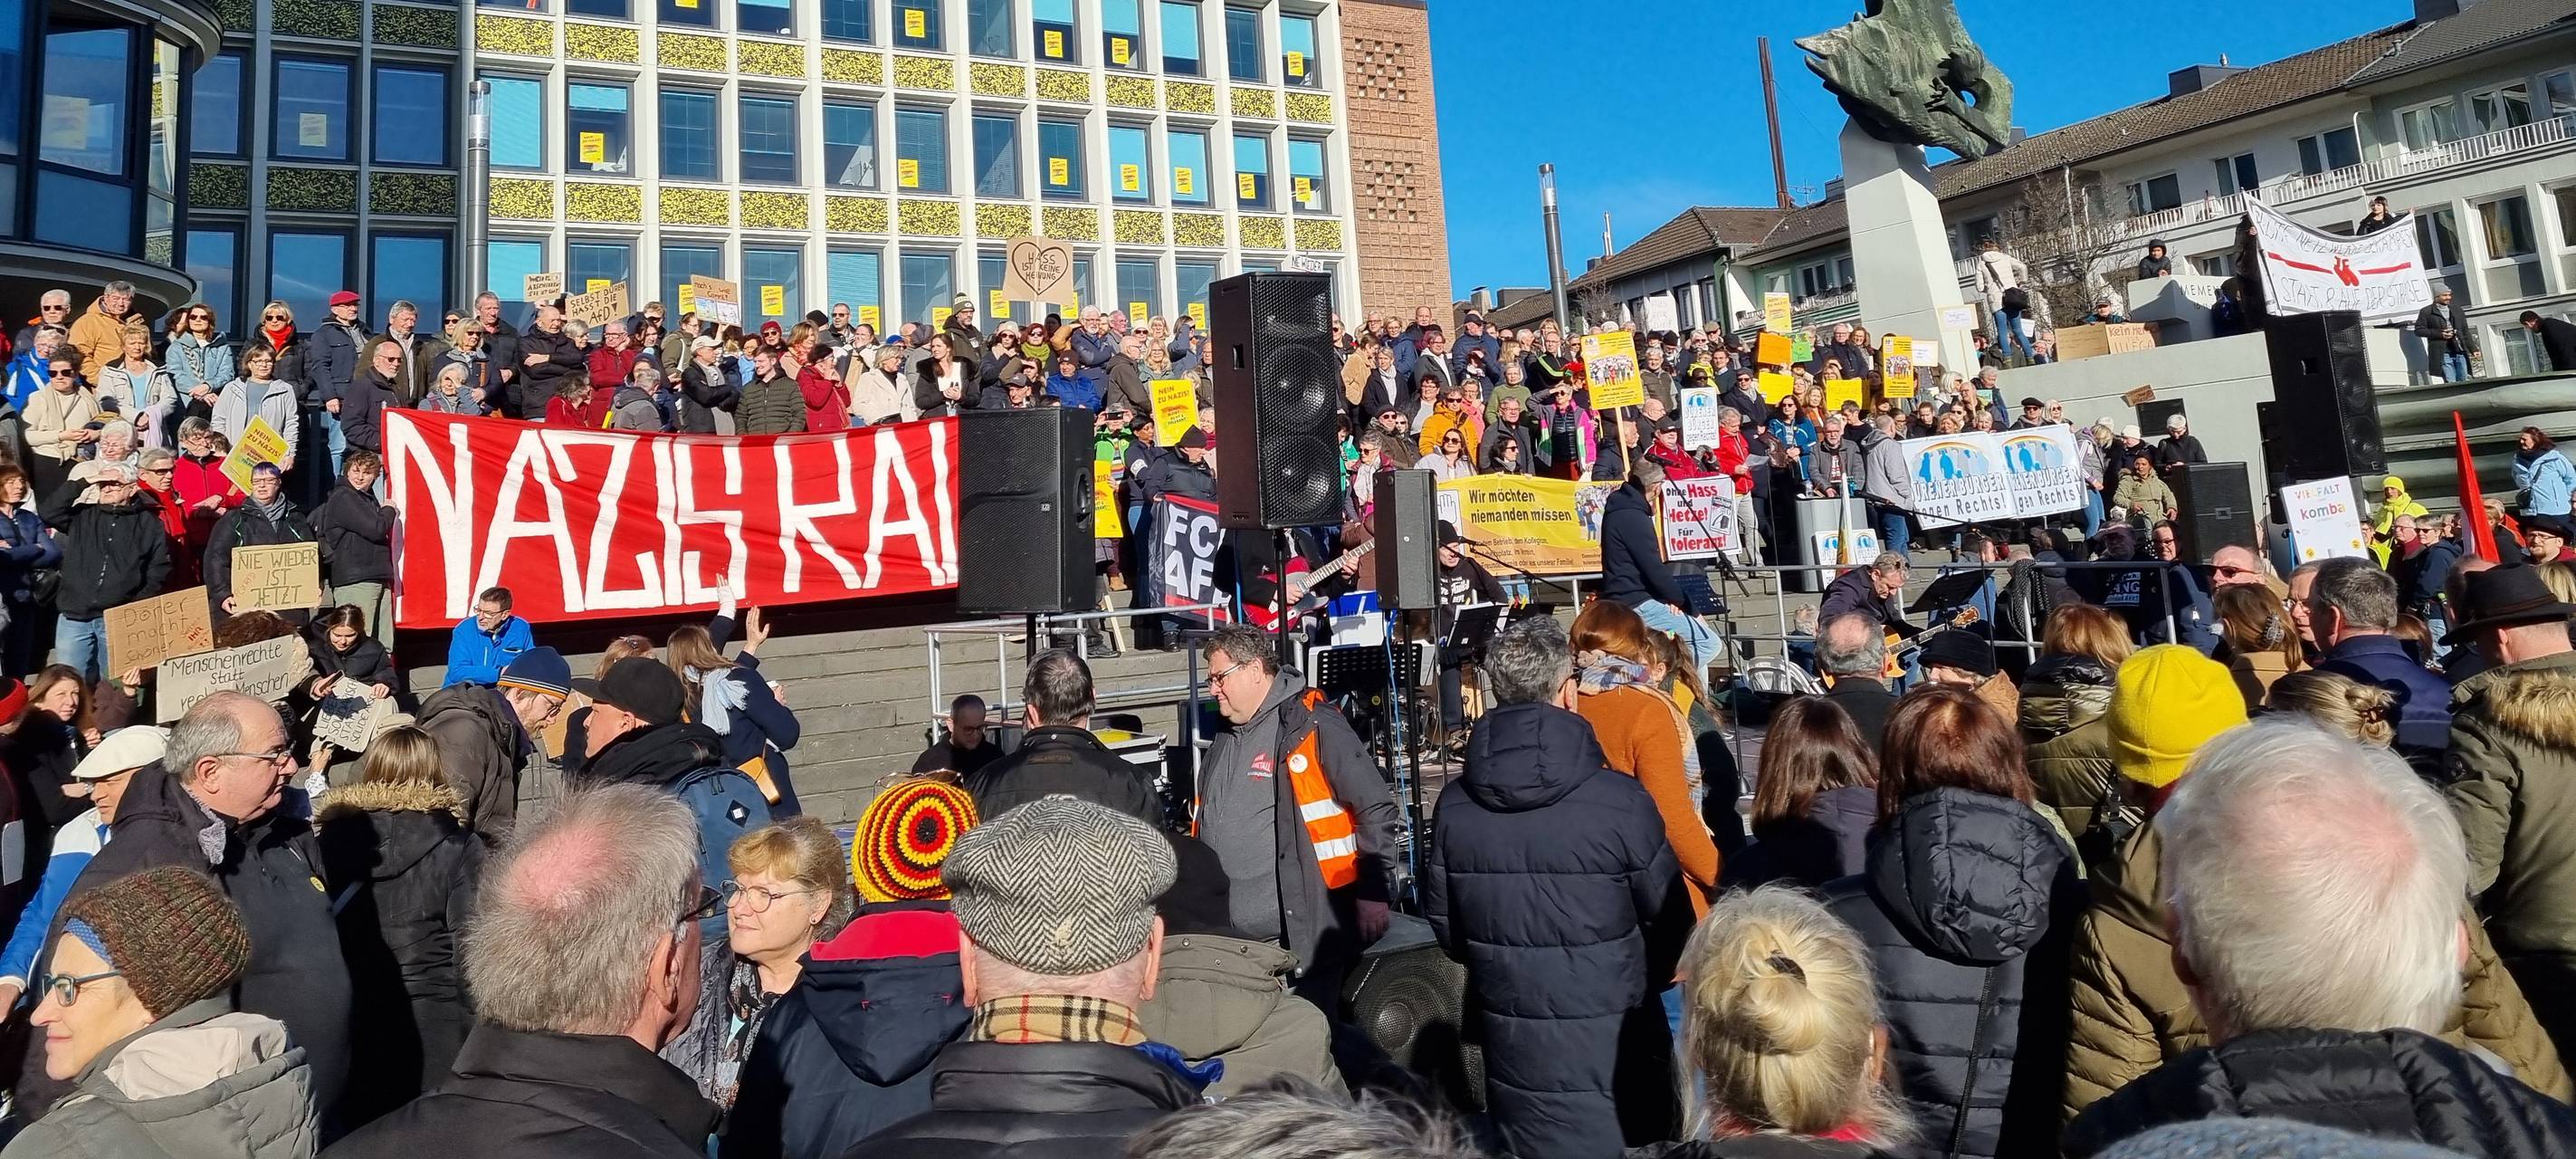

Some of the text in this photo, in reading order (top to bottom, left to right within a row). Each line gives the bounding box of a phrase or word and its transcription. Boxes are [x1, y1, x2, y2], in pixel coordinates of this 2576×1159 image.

[1028, 252, 1055, 264] HASS
[1022, 262, 1061, 273] IST KEINE
[570, 292, 600, 309] SELBST
[571, 293, 617, 317] HASST DIE
[1158, 390, 1190, 404] ZU NAZIS!
[1159, 386, 1175, 395] NEIN
[253, 428, 272, 443] NEIN
[246, 434, 281, 458] ZU NAZIS!
[2038, 465, 2081, 487] BÜRGER
[1468, 488, 1536, 504] Wir möchten
[1665, 484, 1718, 498] Ohne Hass
[1912, 471, 2007, 503] ÜRENER BÜRGER
[2037, 484, 2082, 506] Rechts!
[2295, 484, 2340, 500] VIELFALT
[1676, 499, 1693, 508] und
[1956, 493, 2008, 515] Rechts!
[2300, 503, 2346, 520] komba
[386, 409, 748, 623] NAZIS
[1471, 507, 1572, 523] niemanden missen
[1668, 506, 1709, 522] Hetze!
[1164, 503, 1226, 558] FC
[1677, 527, 1693, 537] Für
[1671, 534, 1727, 552] Toleranz!
[237, 550, 317, 570] NIE WIEDER
[265, 568, 291, 587] IST
[251, 585, 302, 608] JETZT
[123, 596, 188, 628] Döner
[128, 614, 188, 646] macht
[170, 643, 283, 677] Menschenrechte
[210, 667, 245, 685] statt
[235, 672, 290, 697] Menschen
[350, 715, 369, 744] SOLIDE
